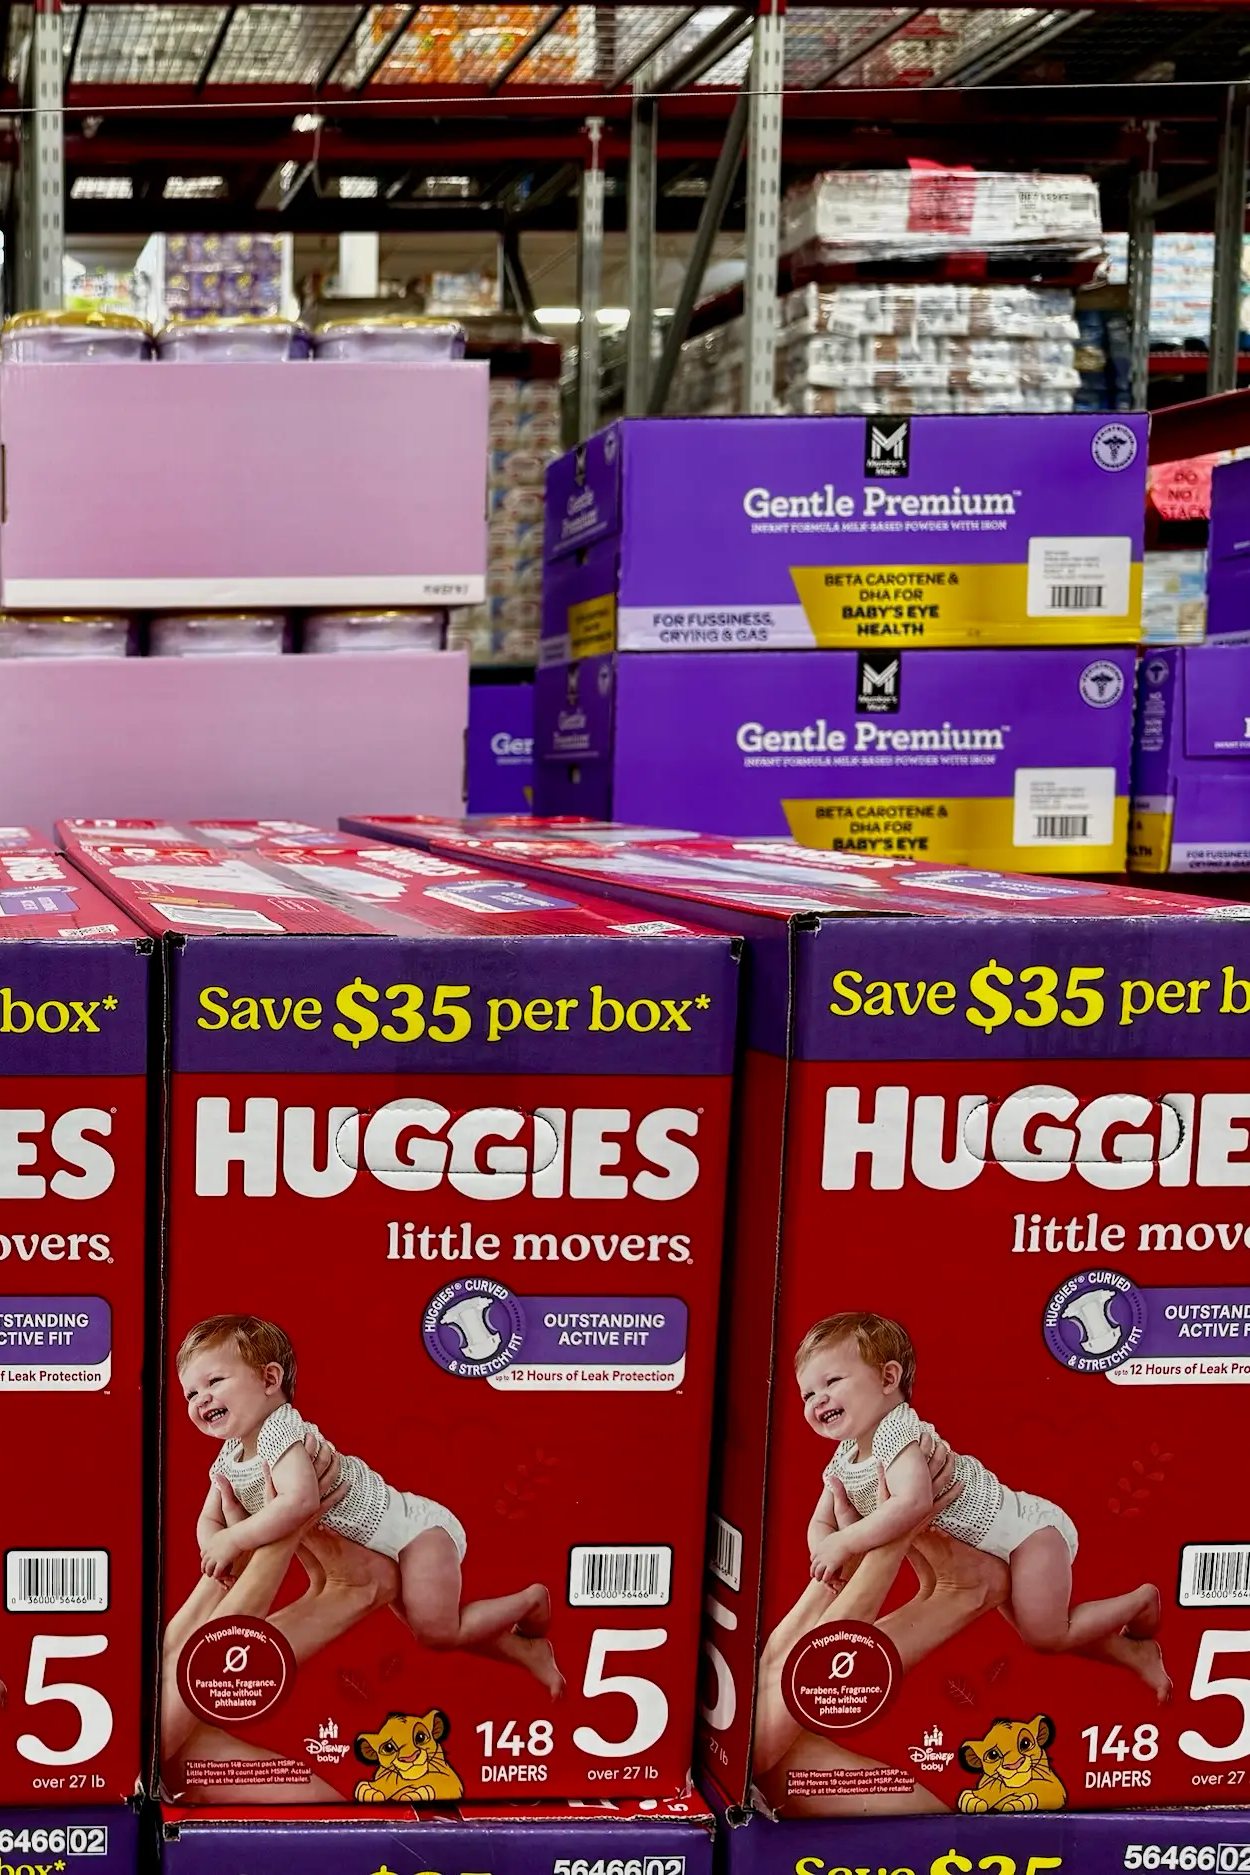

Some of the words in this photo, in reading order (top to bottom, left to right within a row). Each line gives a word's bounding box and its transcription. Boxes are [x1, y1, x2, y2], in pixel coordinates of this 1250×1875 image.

[743, 484, 854, 520] Gentle
[862, 486, 1016, 517] Premium
[824, 574, 864, 587] BETA
[866, 572, 944, 586] CAROTENE
[948, 573, 959, 586] &
[859, 588, 889, 602] DHA
[894, 588, 923, 602] FOR
[653, 613, 684, 628] FOR
[842, 604, 904, 620] BABY'S
[907, 604, 940, 618] EYE
[856, 622, 924, 636] HEALTH
[660, 630, 717, 644] CRYING
[722, 629, 735, 642] &
[736, 628, 768, 642] GAS
[736, 719, 846, 752] Gentle
[854, 722, 1004, 752] Premium
[197, 986, 323, 1032] Save
[332, 977, 472, 1049] $35
[486, 998, 578, 1042] per
[830, 970, 957, 1017] Save
[965, 958, 1106, 1036] $35
[1118, 978, 1211, 1026] per
[195, 1097, 700, 1201] HUGGIES
[821, 1084, 1250, 1191] HUGGIE
[386, 1222, 501, 1260] little
[513, 1230, 691, 1262] movers
[1012, 1213, 1126, 1254] little
[48, 1331, 74, 1346] FIT
[16, 1634, 114, 1767] 5
[572, 1628, 669, 1759] 5
[1081, 1724, 1159, 1762] 148
[32, 1776, 66, 1790] over
[69, 1774, 88, 1789] 27
[90, 1773, 106, 1789] lb
